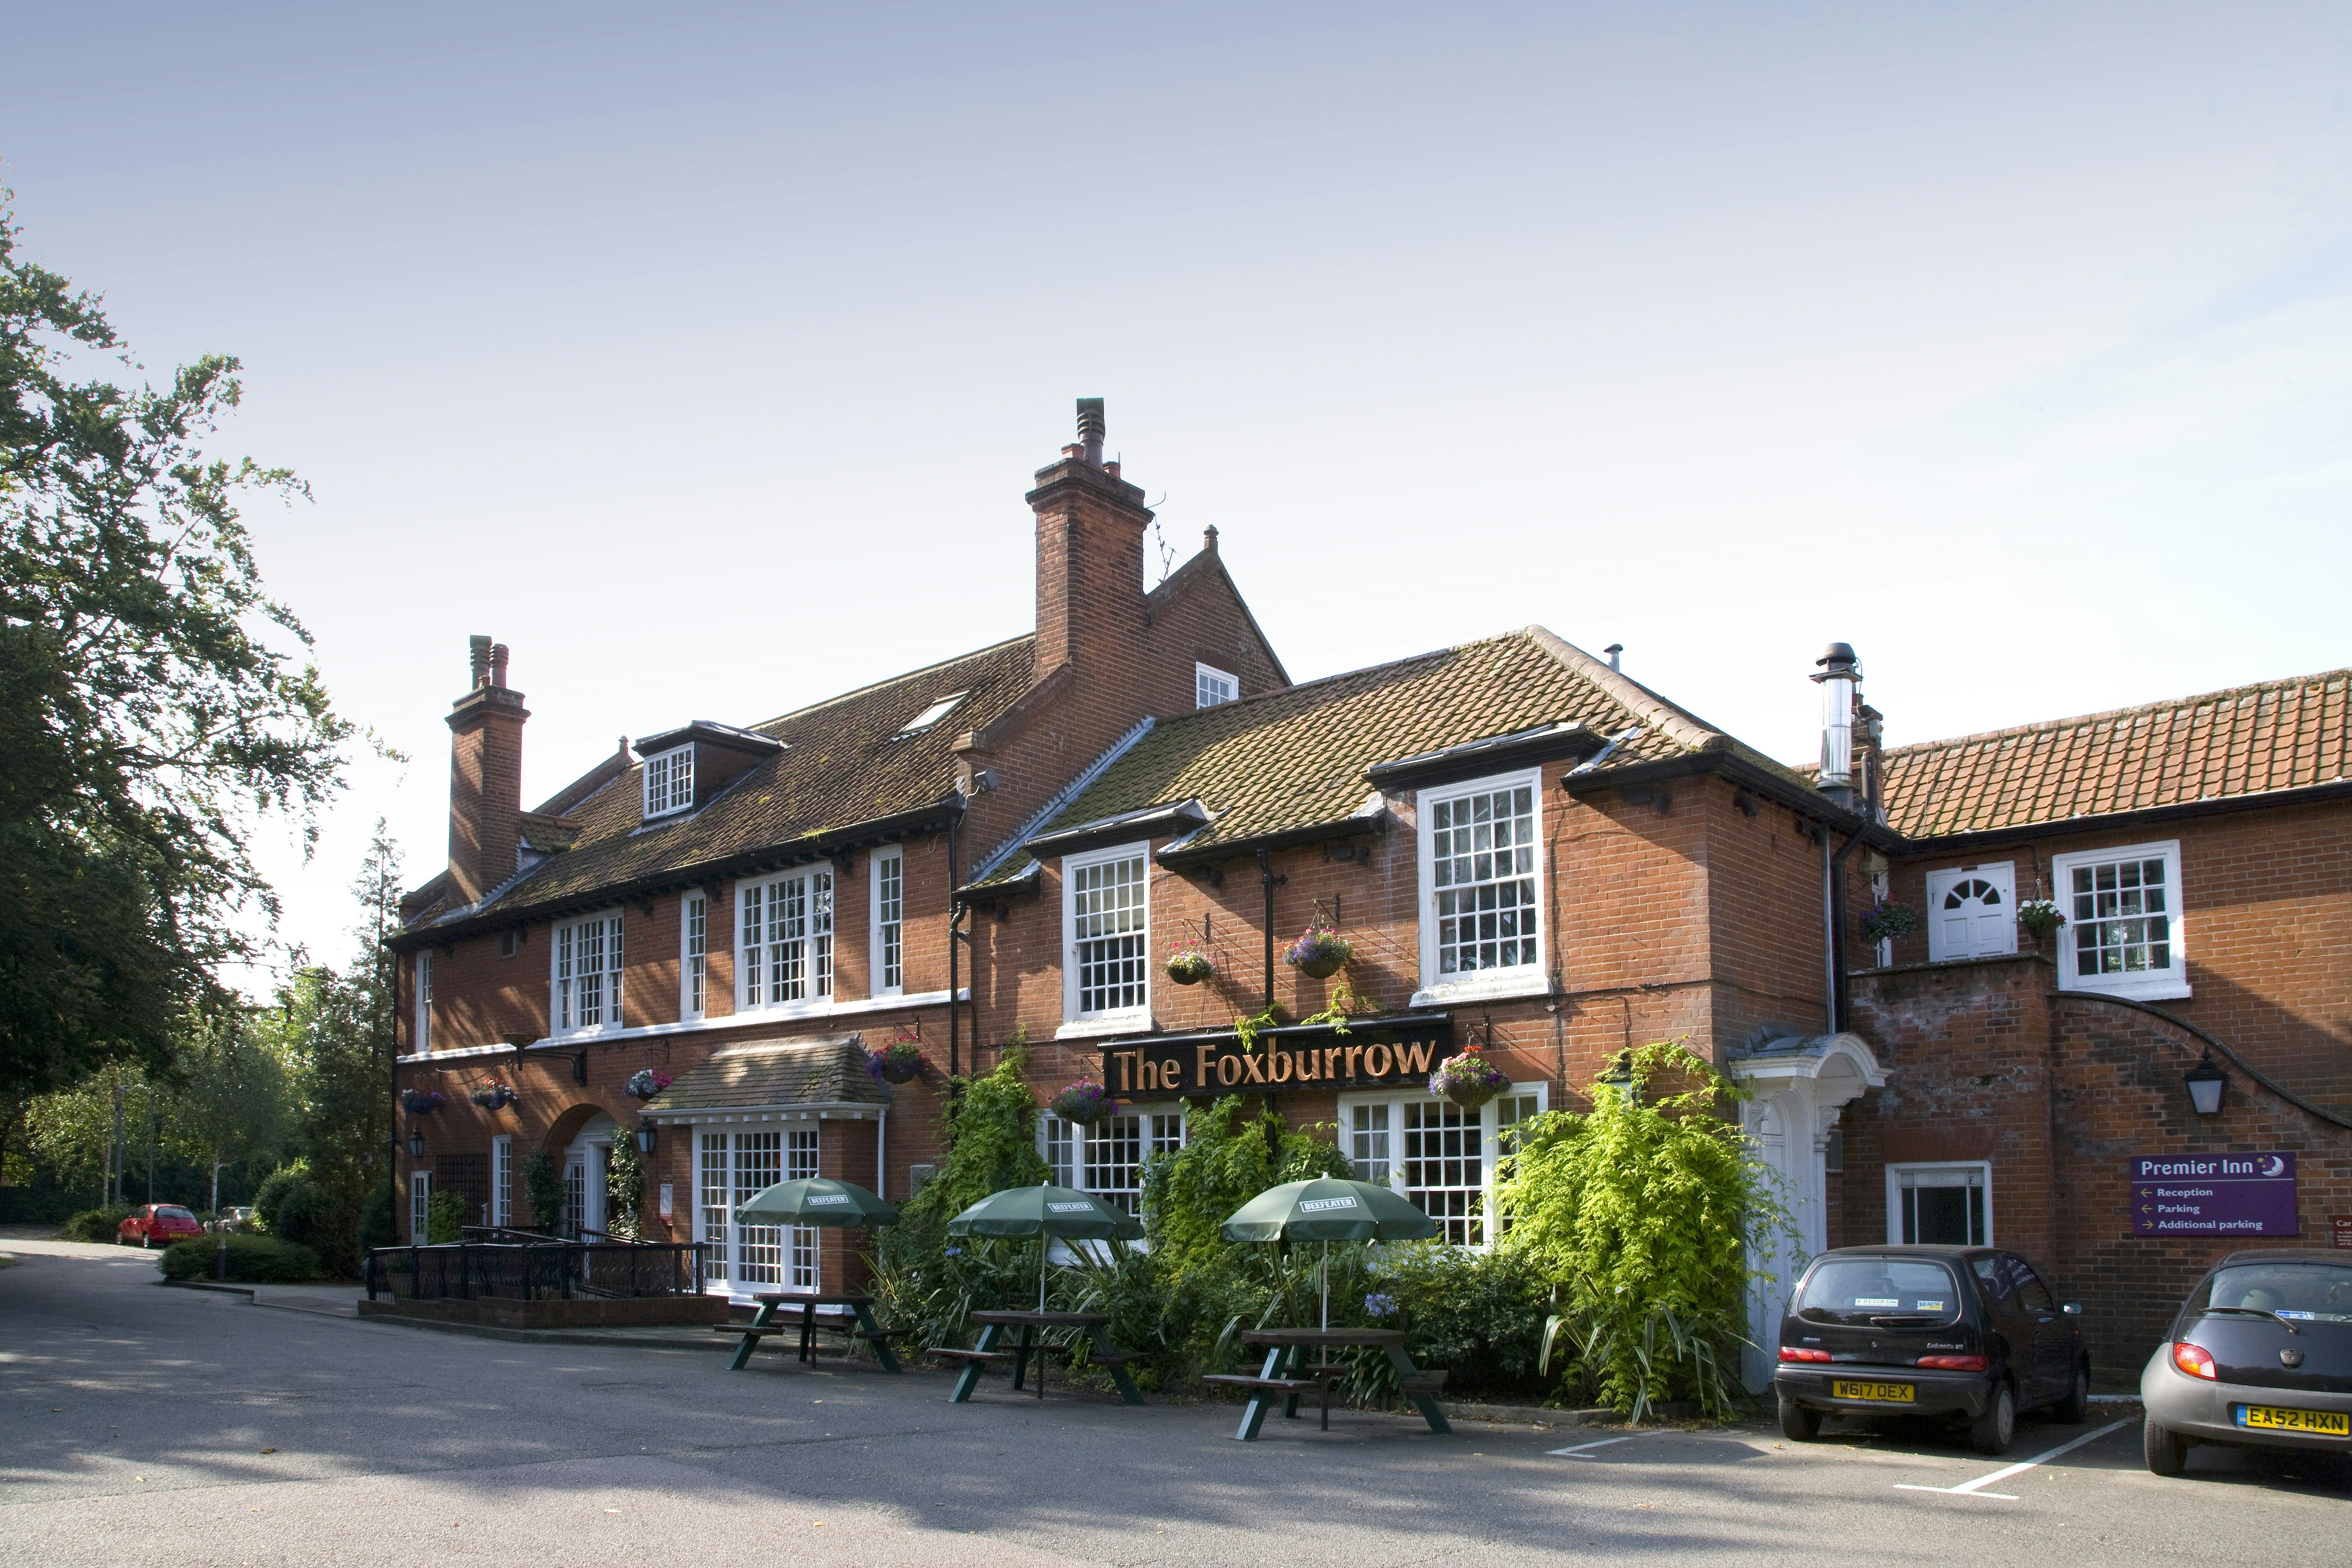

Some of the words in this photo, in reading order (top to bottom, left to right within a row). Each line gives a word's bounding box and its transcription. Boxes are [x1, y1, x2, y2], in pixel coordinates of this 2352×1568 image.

[1113, 1047, 1181, 1091] The
[1196, 1037, 1436, 1086] Foxburrow
[2141, 1160, 2217, 1175] Premier
[2222, 1159, 2253, 1173] Inn
[2157, 1188, 2213, 1198] Reception
[1304, 1199, 1353, 1210] BEEFEATER
[2157, 1204, 2200, 1214] Parking
[2158, 1220, 2216, 1229] Additional
[2219, 1220, 2263, 1231] parking
[1839, 1382, 1872, 1396] W617
[2249, 1408, 2299, 1426] EA52
[2305, 1413, 2344, 1430] HXN
